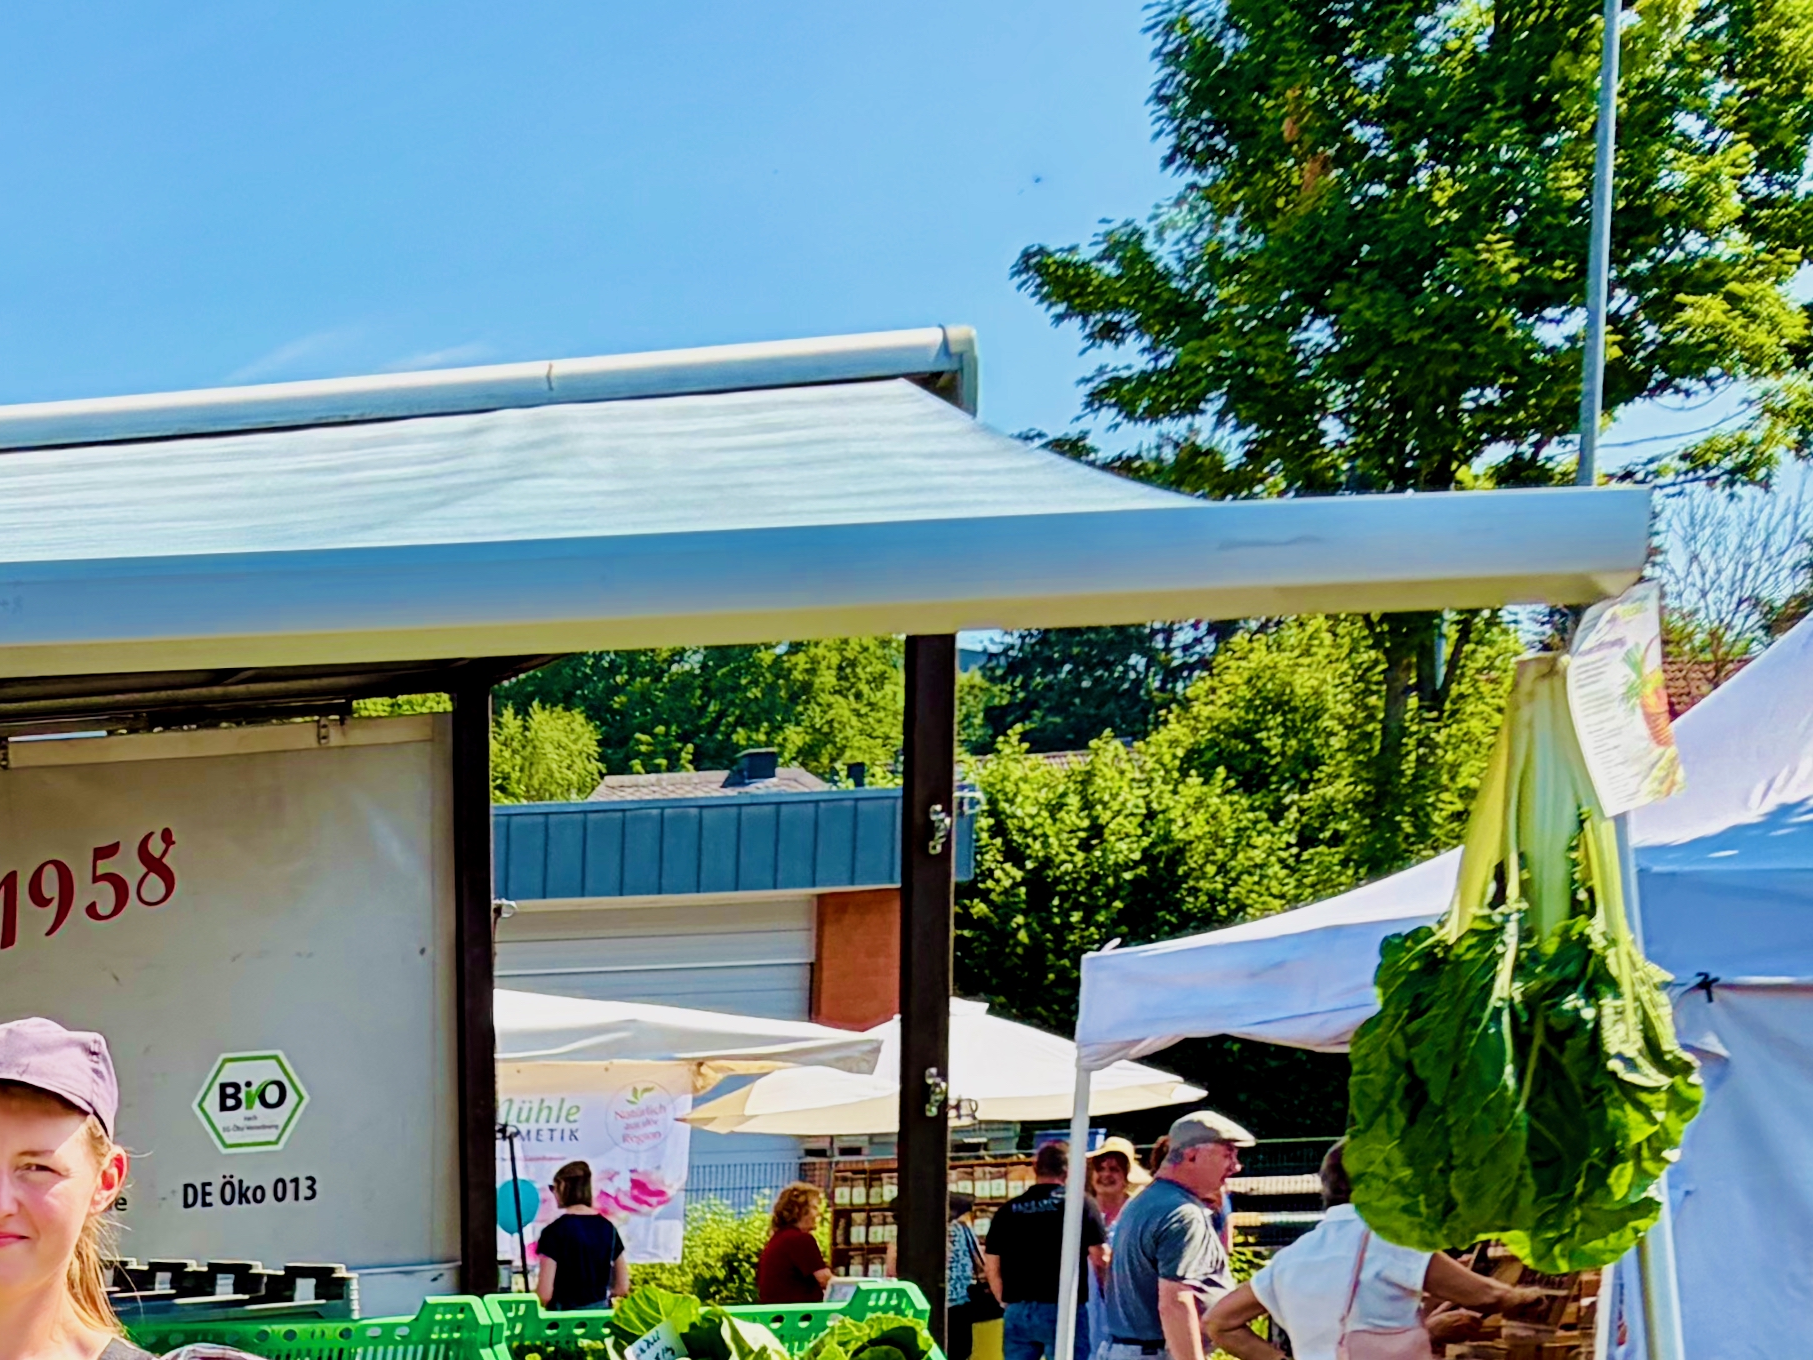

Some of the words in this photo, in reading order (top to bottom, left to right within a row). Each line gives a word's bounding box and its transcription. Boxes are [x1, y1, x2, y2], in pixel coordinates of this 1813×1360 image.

[183, 1182, 213, 1208] DE
[220, 1174, 266, 1206] Öko
[273, 1175, 317, 1203] 013
